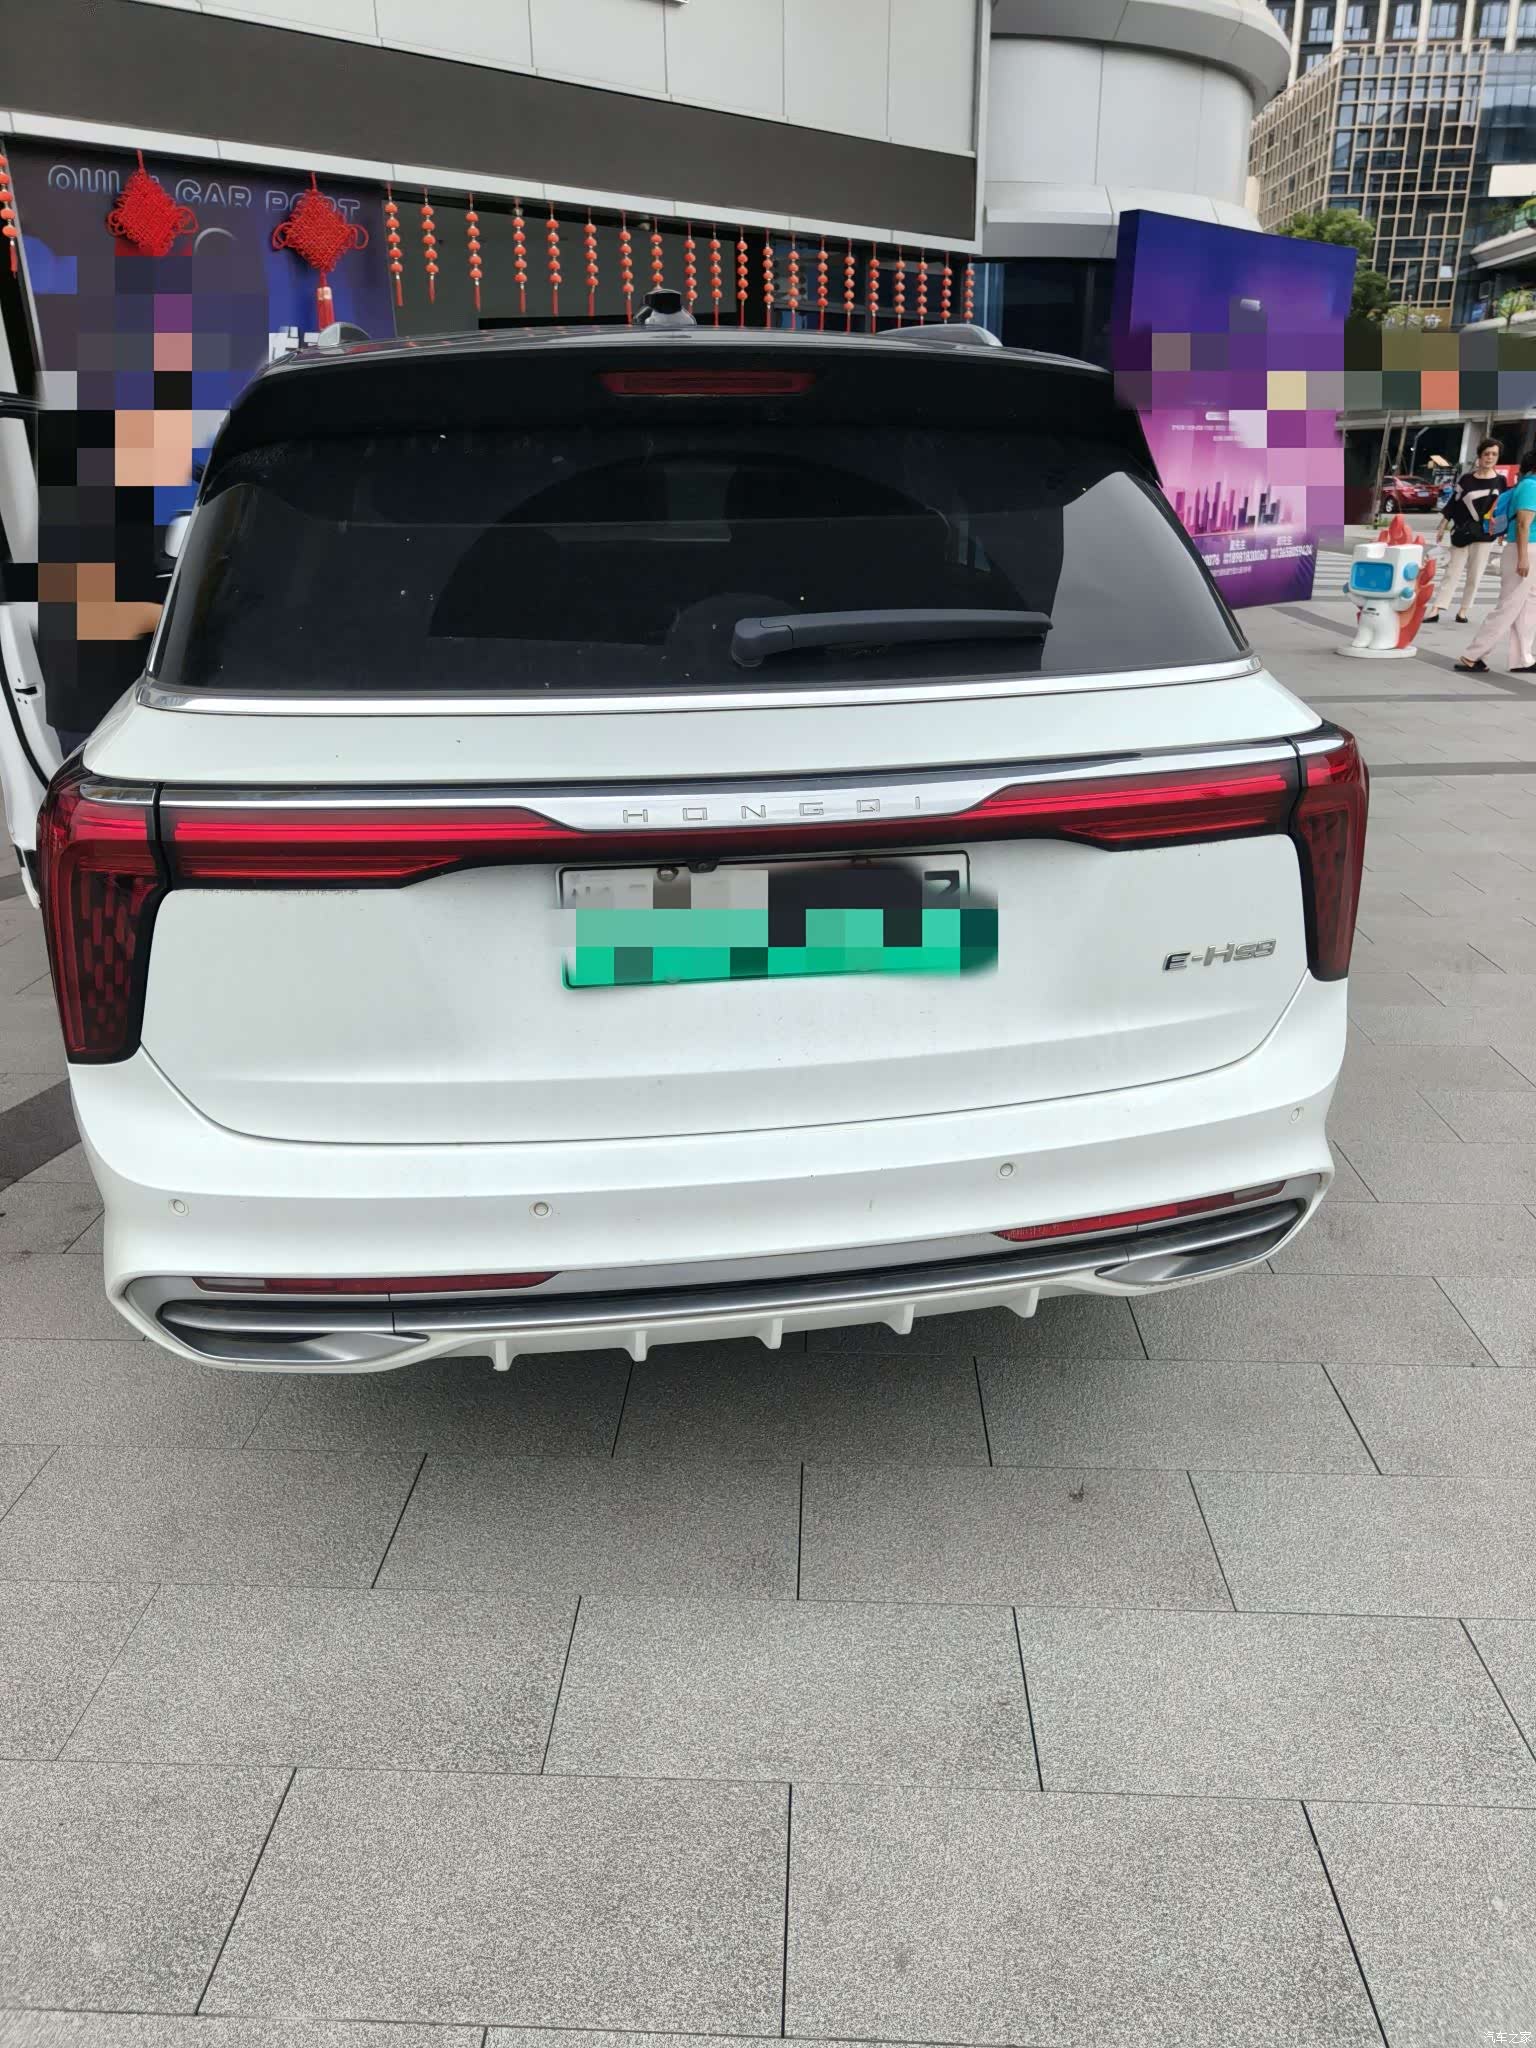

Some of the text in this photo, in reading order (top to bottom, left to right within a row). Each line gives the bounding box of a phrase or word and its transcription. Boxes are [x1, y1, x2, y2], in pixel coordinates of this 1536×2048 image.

[175, 178, 252, 209] CAR
[622, 795, 921, 824] HONGQI
[1162, 939, 1277, 972] E-HS9
